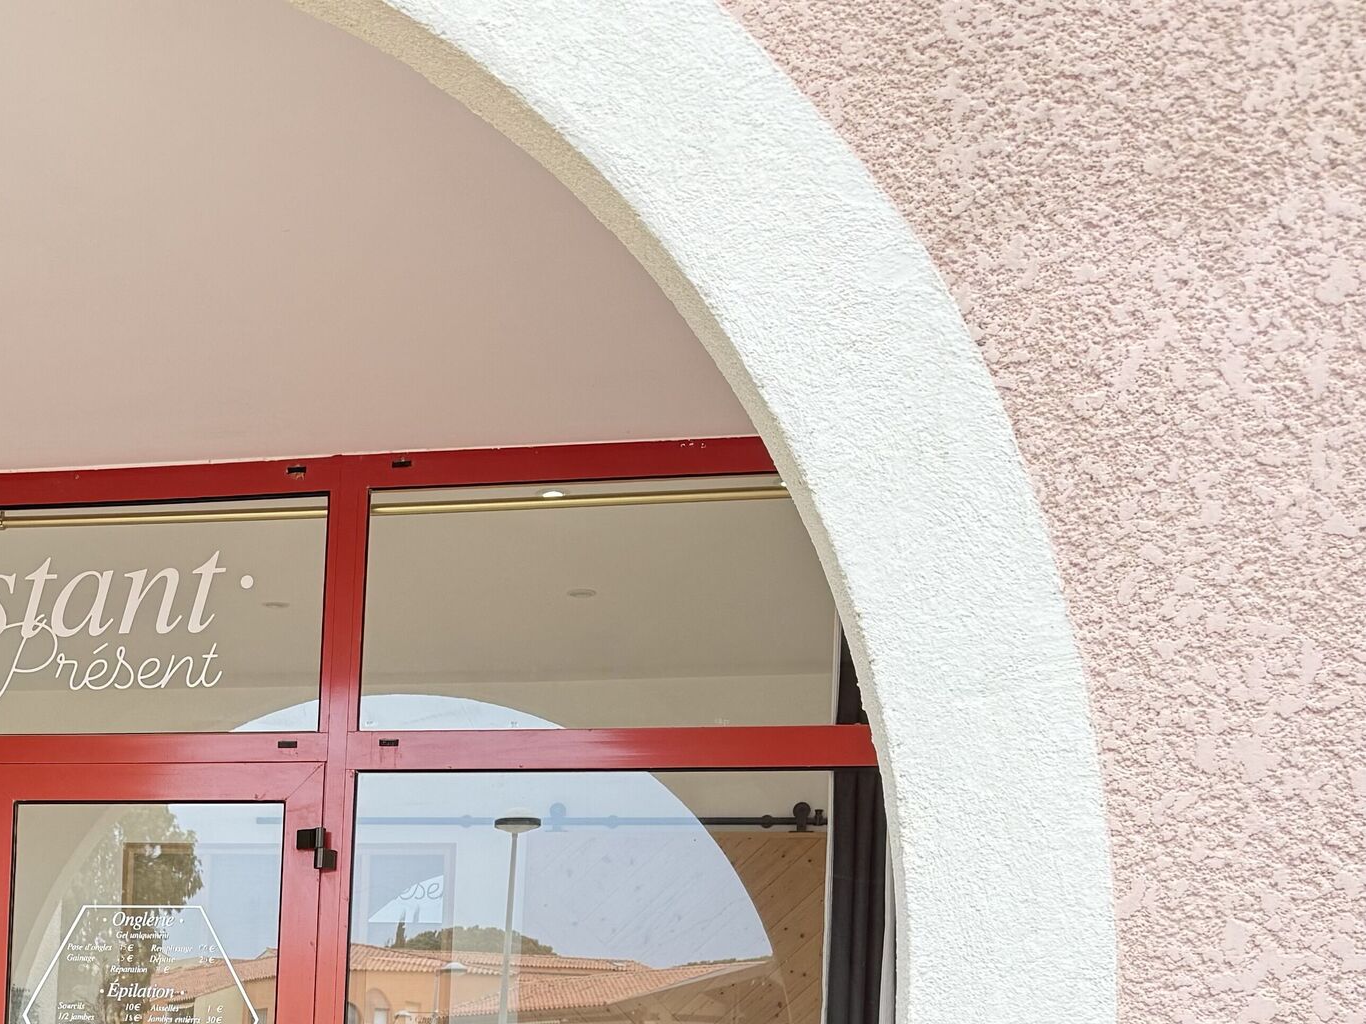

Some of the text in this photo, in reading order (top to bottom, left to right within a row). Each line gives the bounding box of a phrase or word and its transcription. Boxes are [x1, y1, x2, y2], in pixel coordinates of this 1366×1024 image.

[112, 911, 175, 930] Onglerie
[67, 943, 83, 951] Pose
[66, 953, 95, 962] Gainage
[110, 965, 148, 974] Réparation
[107, 977, 174, 1001] Épilation
[57, 1001, 141, 1011] Sourcils 10€
[150, 1004, 223, 1013] Aisselles 1€
[58, 1012, 69, 1020] 1/2
[69, 1013, 95, 1022] jambes
